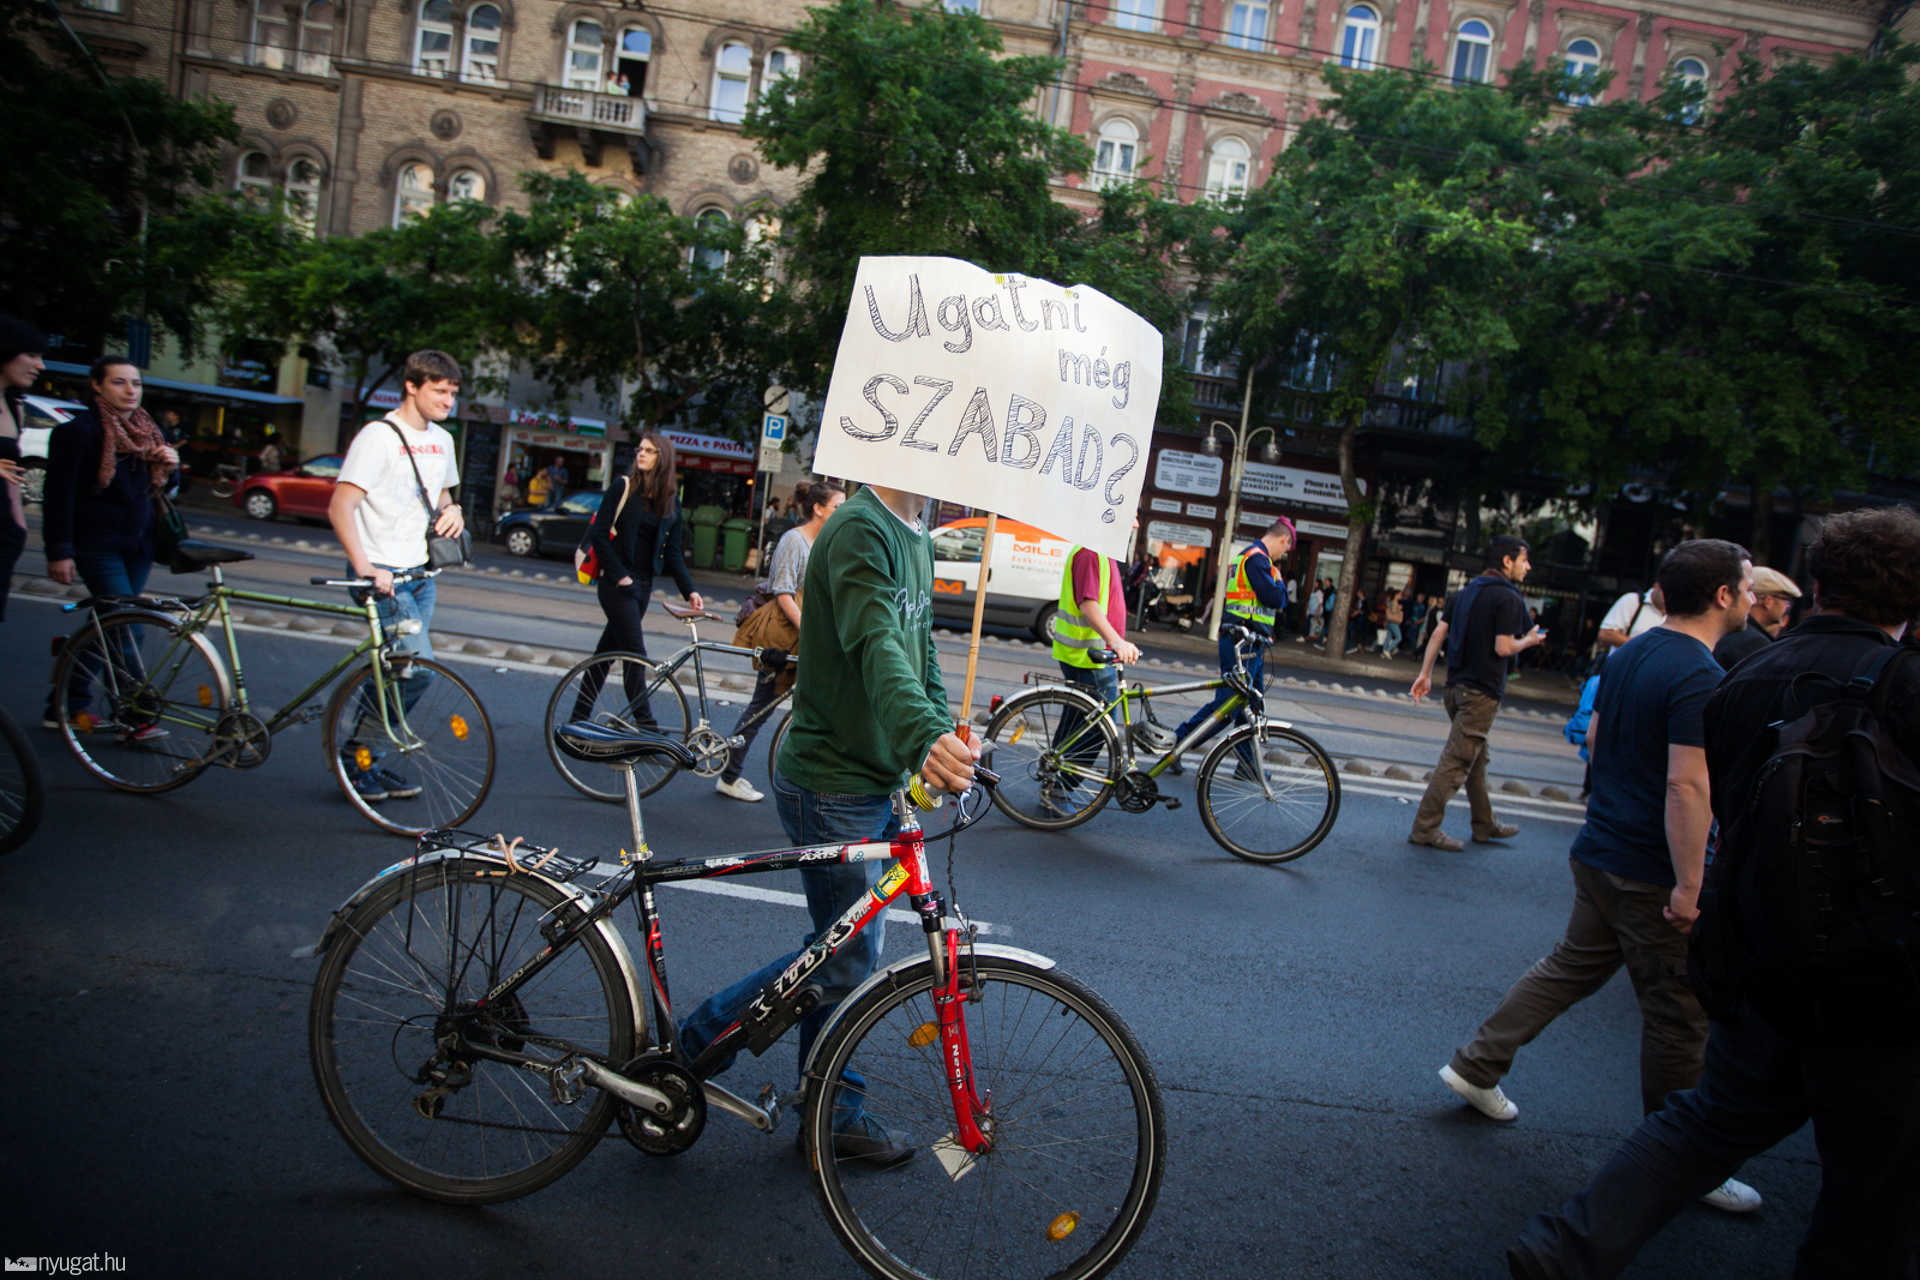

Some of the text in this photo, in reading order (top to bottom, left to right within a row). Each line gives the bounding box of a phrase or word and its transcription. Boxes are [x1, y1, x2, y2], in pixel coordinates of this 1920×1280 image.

[864, 273, 1087, 353] Ugatni
[1058, 346, 1132, 409] még
[669, 434, 699, 447] PIZZA
[768, 419, 781, 436] P
[839, 373, 1138, 524] SZABAD?
